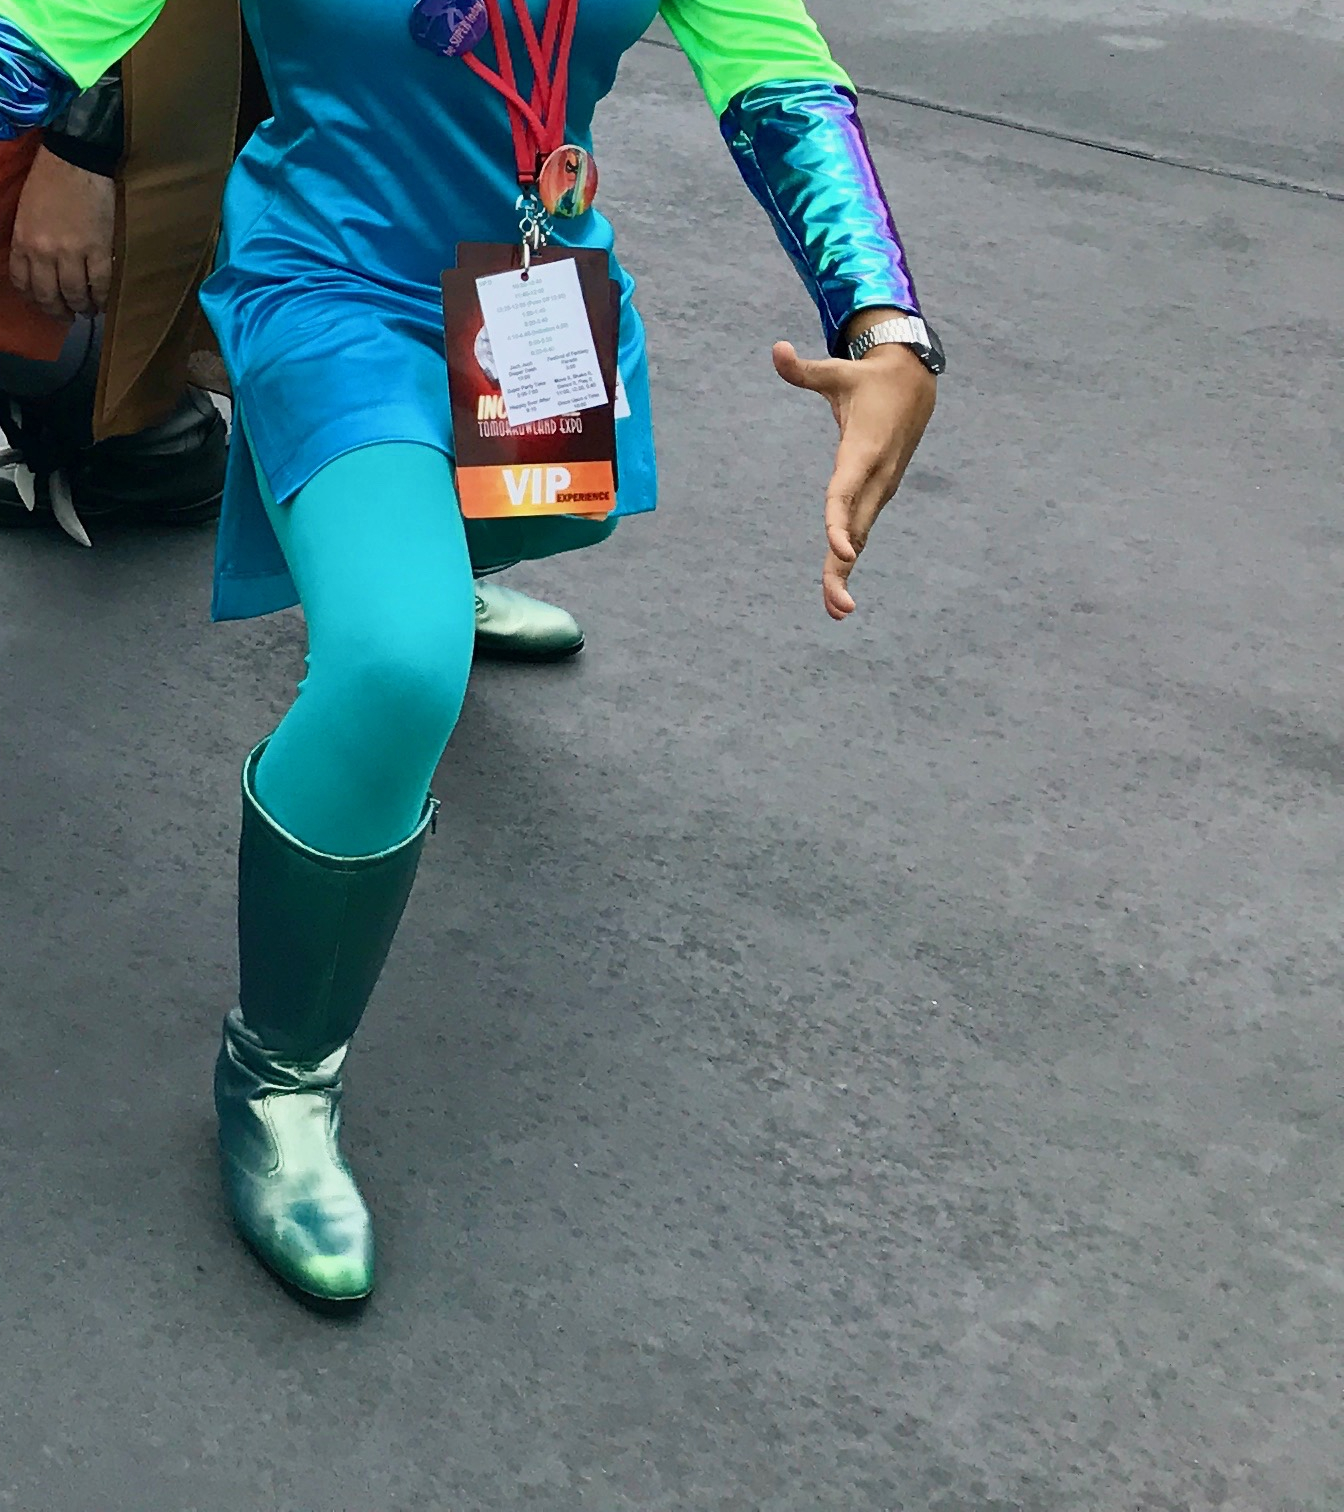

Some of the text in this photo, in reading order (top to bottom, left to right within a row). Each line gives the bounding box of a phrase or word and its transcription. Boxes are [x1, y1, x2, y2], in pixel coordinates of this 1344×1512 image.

[449, 19, 473, 48] SUPER
[559, 417, 583, 434] EXPO
[502, 466, 572, 506] VIP
[556, 491, 611, 503] EXPERIENCE
